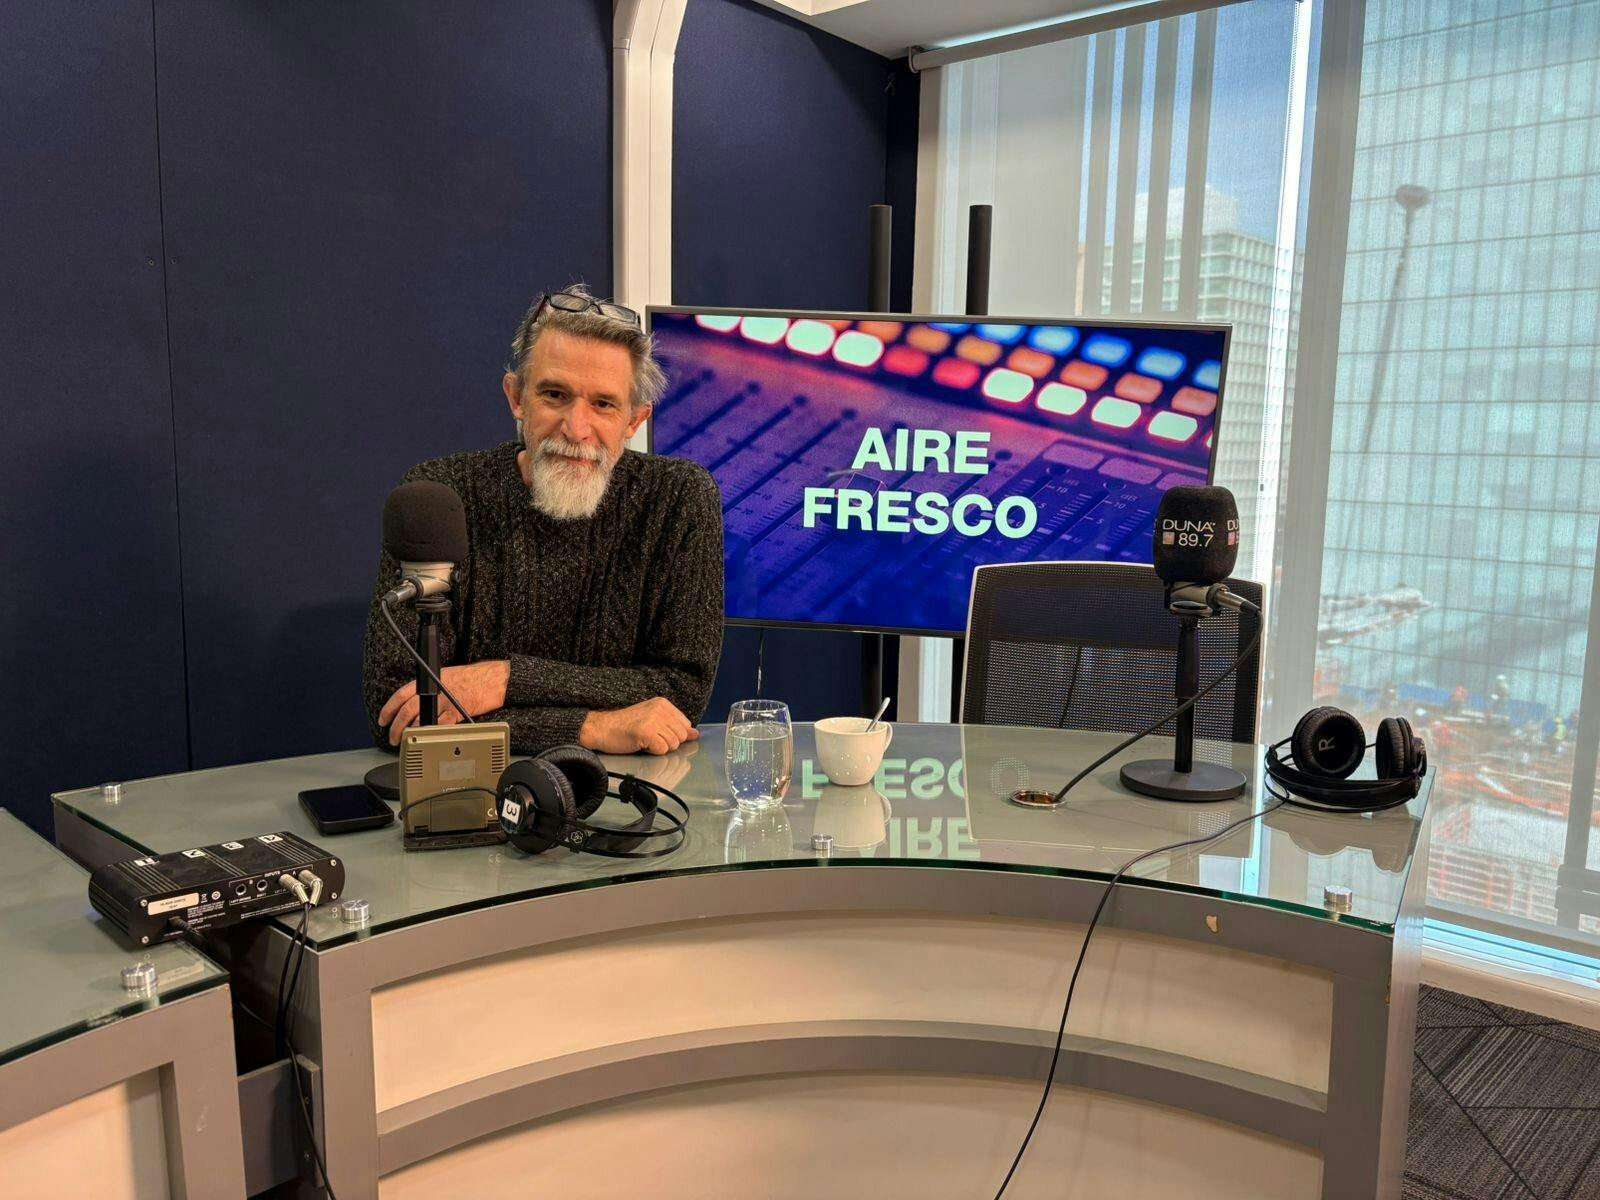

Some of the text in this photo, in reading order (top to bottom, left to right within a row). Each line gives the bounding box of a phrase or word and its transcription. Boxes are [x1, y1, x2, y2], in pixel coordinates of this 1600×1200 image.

[852, 427, 991, 475] AIRE
[803, 487, 1038, 538] FRESCO
[1162, 519, 1214, 533] DUNA
[1227, 519, 1239, 531] DU
[1178, 532, 1214, 547] 89.7
[1318, 736, 1336, 752] R
[506, 803, 517, 817] 3
[264, 870, 281, 878] INPUTS
